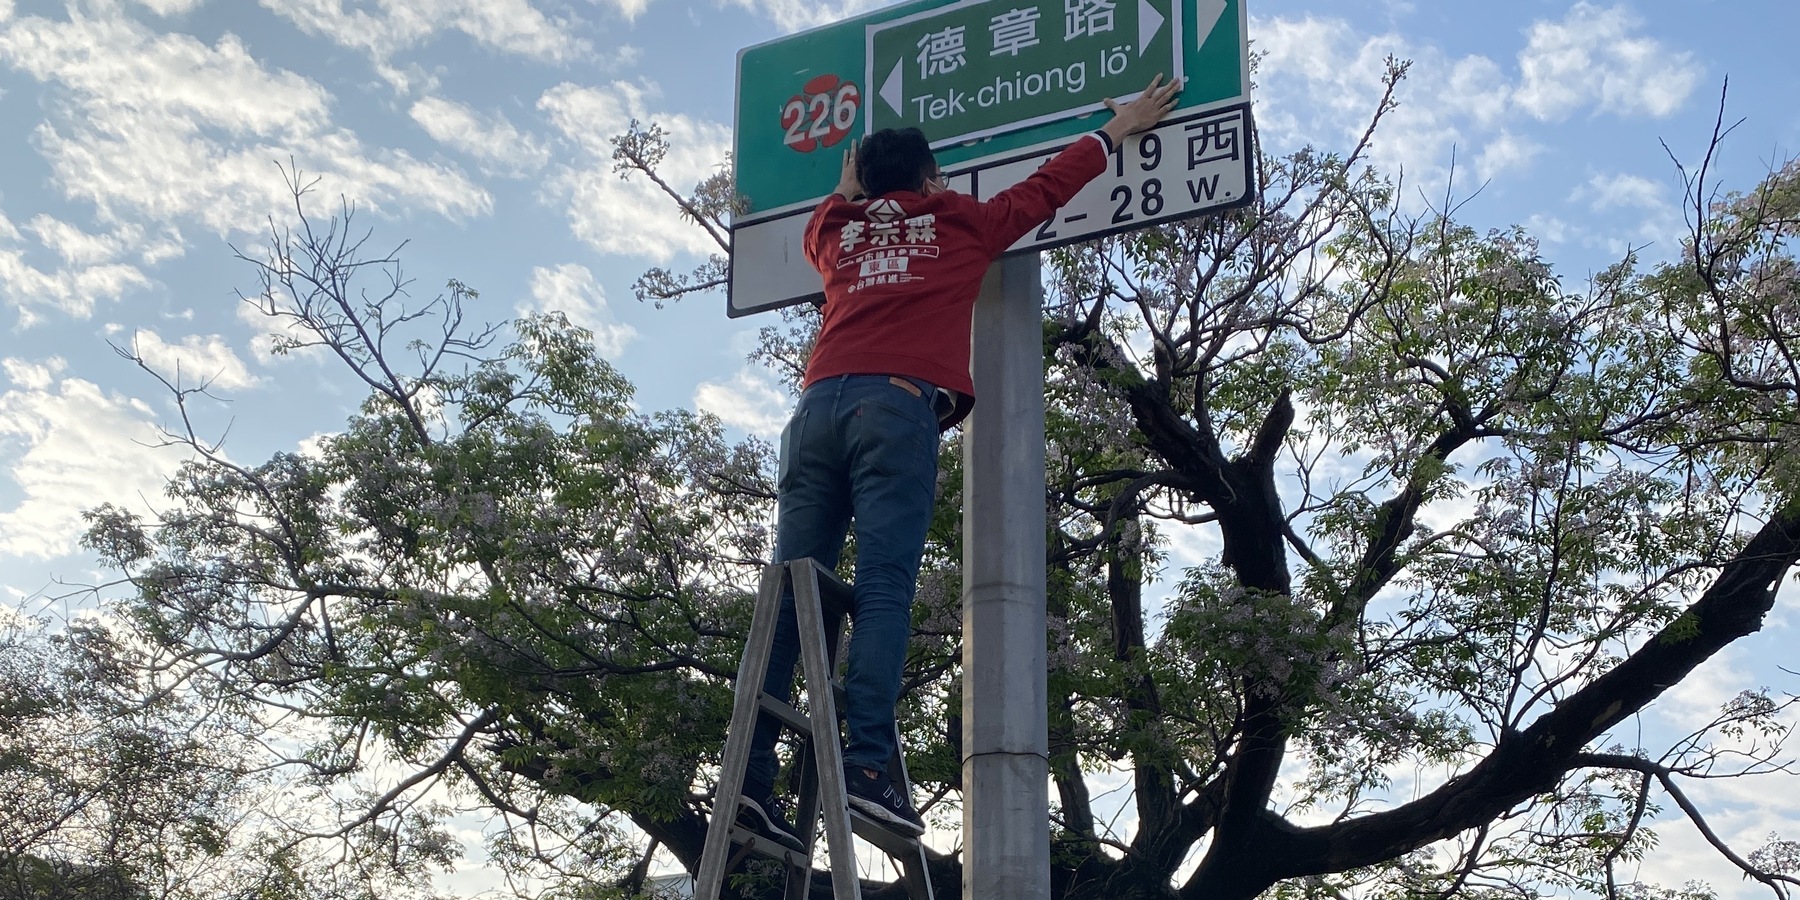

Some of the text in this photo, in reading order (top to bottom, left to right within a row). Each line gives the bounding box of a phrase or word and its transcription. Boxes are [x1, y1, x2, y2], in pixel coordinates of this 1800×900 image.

[917, 0, 1116, 80] 德章路
[783, 85, 858, 145] 226
[911, 61, 1086, 123] Tek-chiong
[1184, 114, 1241, 171] 西
[839, 213, 937, 252] 李宗霖
[868, 259, 900, 273] 東區
